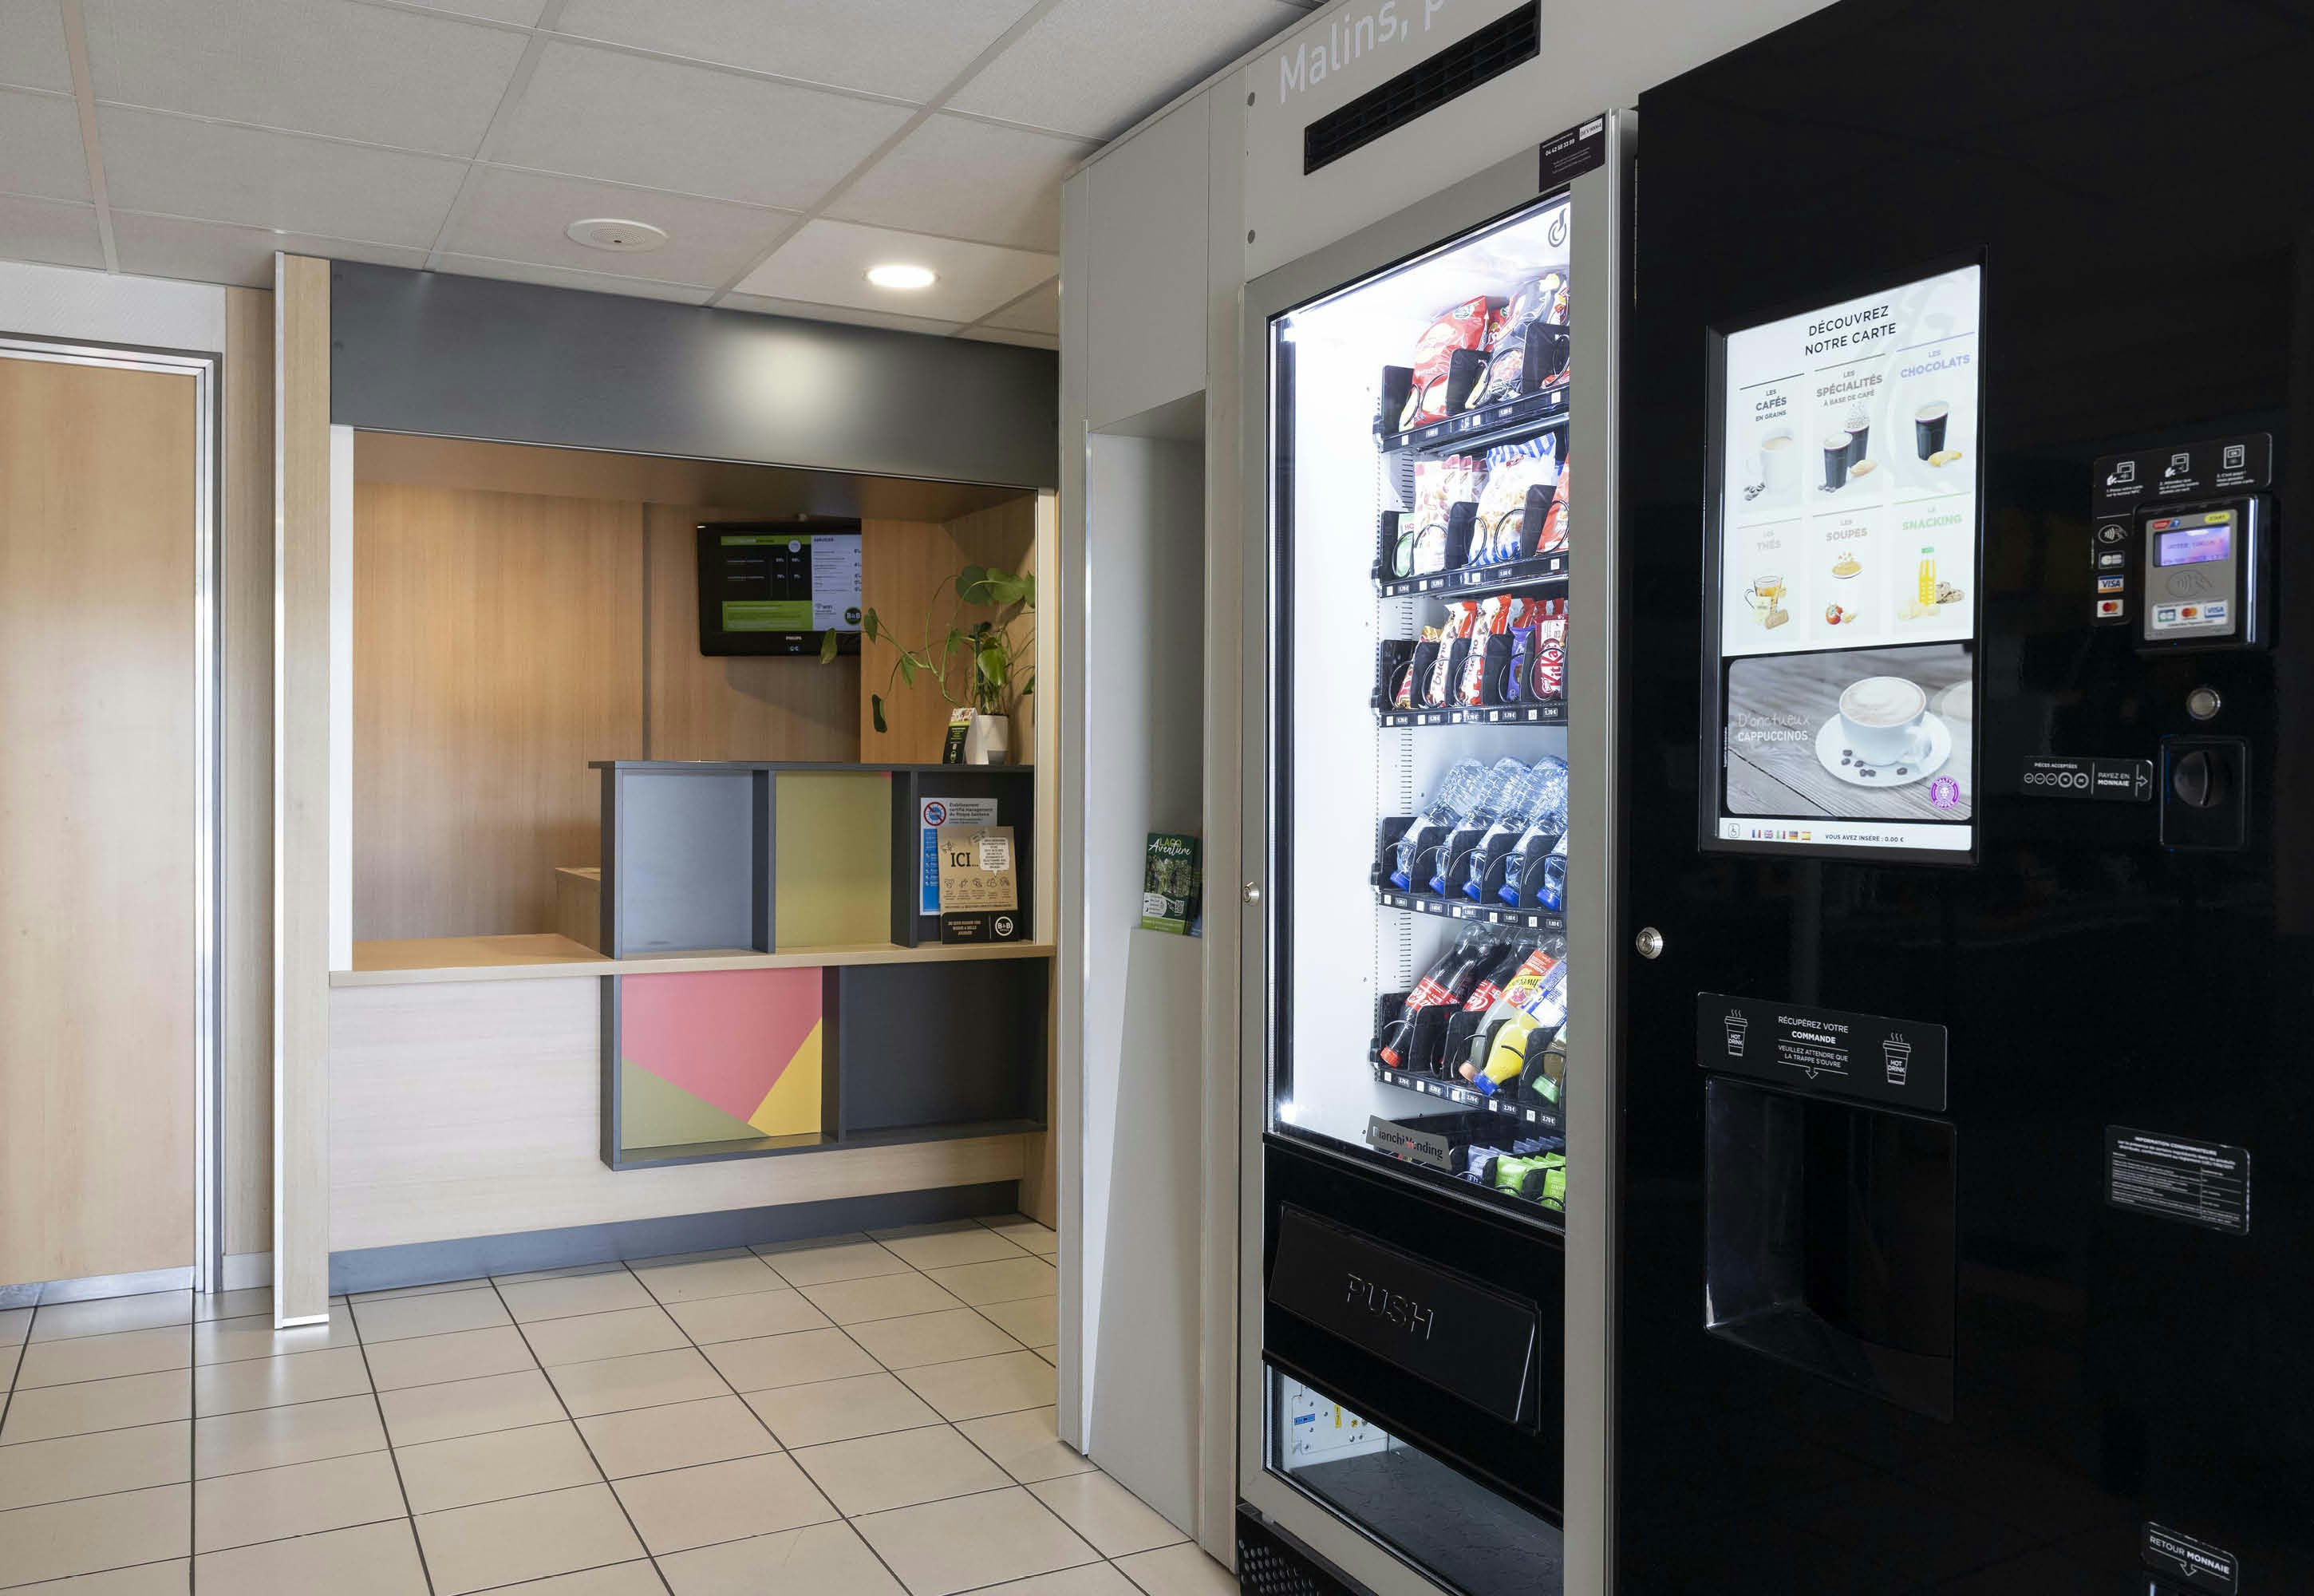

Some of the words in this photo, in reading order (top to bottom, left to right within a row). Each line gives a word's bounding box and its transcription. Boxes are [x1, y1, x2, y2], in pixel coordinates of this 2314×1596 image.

[1280, 0, 1409, 105] Malins,
[1809, 306, 1890, 337] DÉCOUVREZ
[1805, 338, 1848, 356] NOTRE
[1852, 322, 1897, 343] CARTE
[1928, 350, 1941, 358] LES
[1843, 369, 1855, 378] LES
[1900, 354, 1971, 378] CHOCOLATS
[1816, 374, 1883, 398] SPÉCIALITÉS
[1755, 396, 1787, 411] CAFÉS
[1765, 410, 1786, 419] GRAINS
[1902, 514, 1962, 531] SNACKING
[1826, 527, 1867, 541] SOUPES
[1757, 538, 1781, 551] THÉS
[1540, 648, 1565, 687] KitKa
[1738, 731, 1808, 742] CAPPUCCINOS
[2098, 772, 2119, 780] PAYEZ
[1149, 839, 1191, 855] Aventure
[1778, 1015, 1822, 1029] RÉCUPÉREZ
[1822, 1023, 1849, 1033] VOTRE
[1791, 1031, 1836, 1044] COMMANDE
[1778, 1045, 1804, 1054] VEUILLEZ
[1805, 1049, 1834, 1060] ATTENDRE
[1794, 1055, 1815, 1064] TRAPPE
[1816, 1058, 1841, 1068] S'OUVRE
[1347, 1273, 1434, 1341] PUSH
[2150, 1535, 2185, 1555] RETOUR
[2186, 1551, 2230, 1574] MONNAIE
